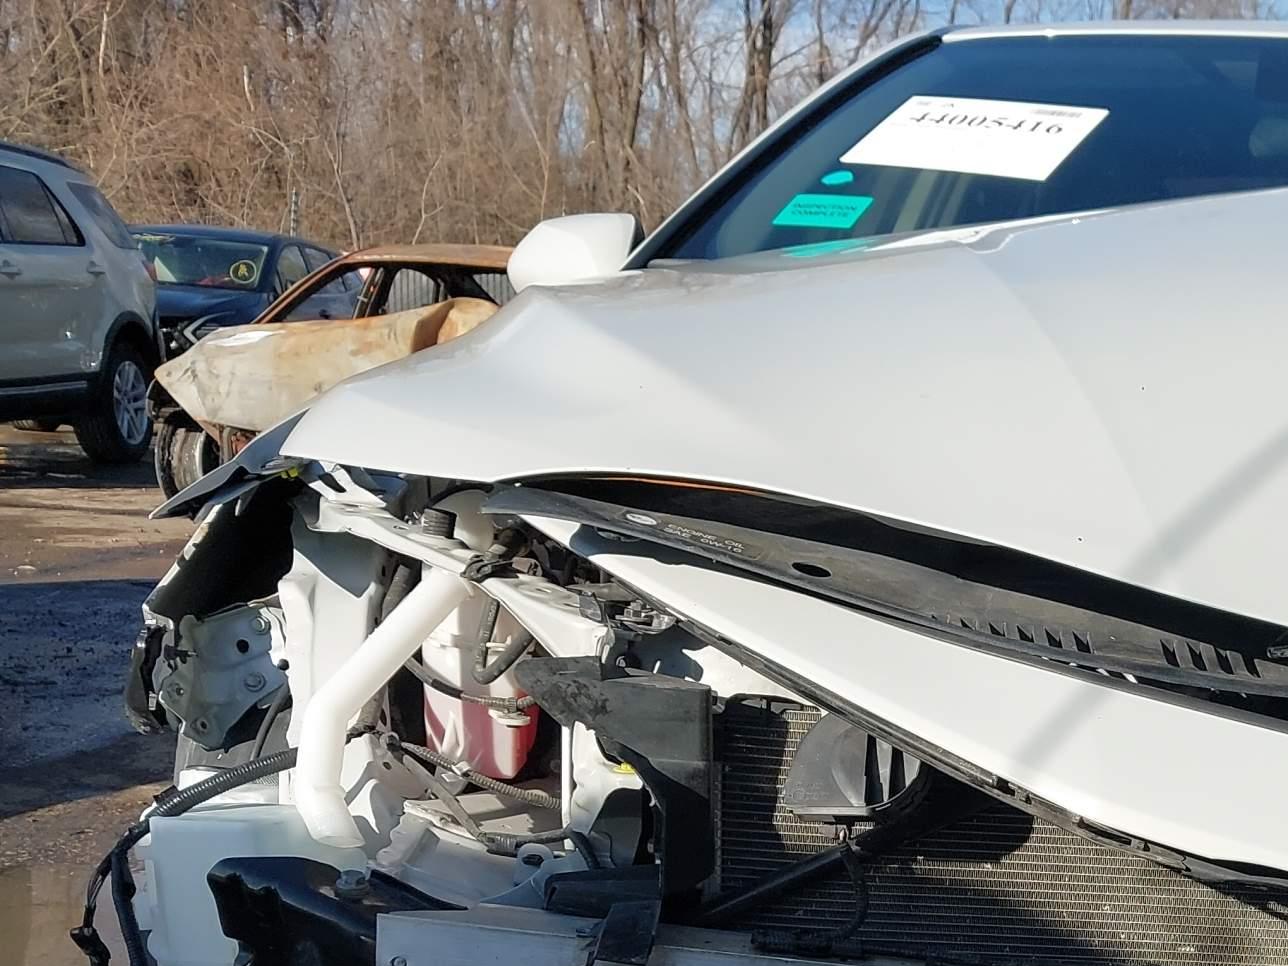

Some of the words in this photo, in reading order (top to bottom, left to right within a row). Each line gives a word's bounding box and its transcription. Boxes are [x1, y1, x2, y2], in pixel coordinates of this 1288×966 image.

[909, 111, 1064, 135] 44005416
[663, 527, 693, 539] SAE
[667, 523, 718, 540] ENGINE
[724, 539, 746, 550] OIL
